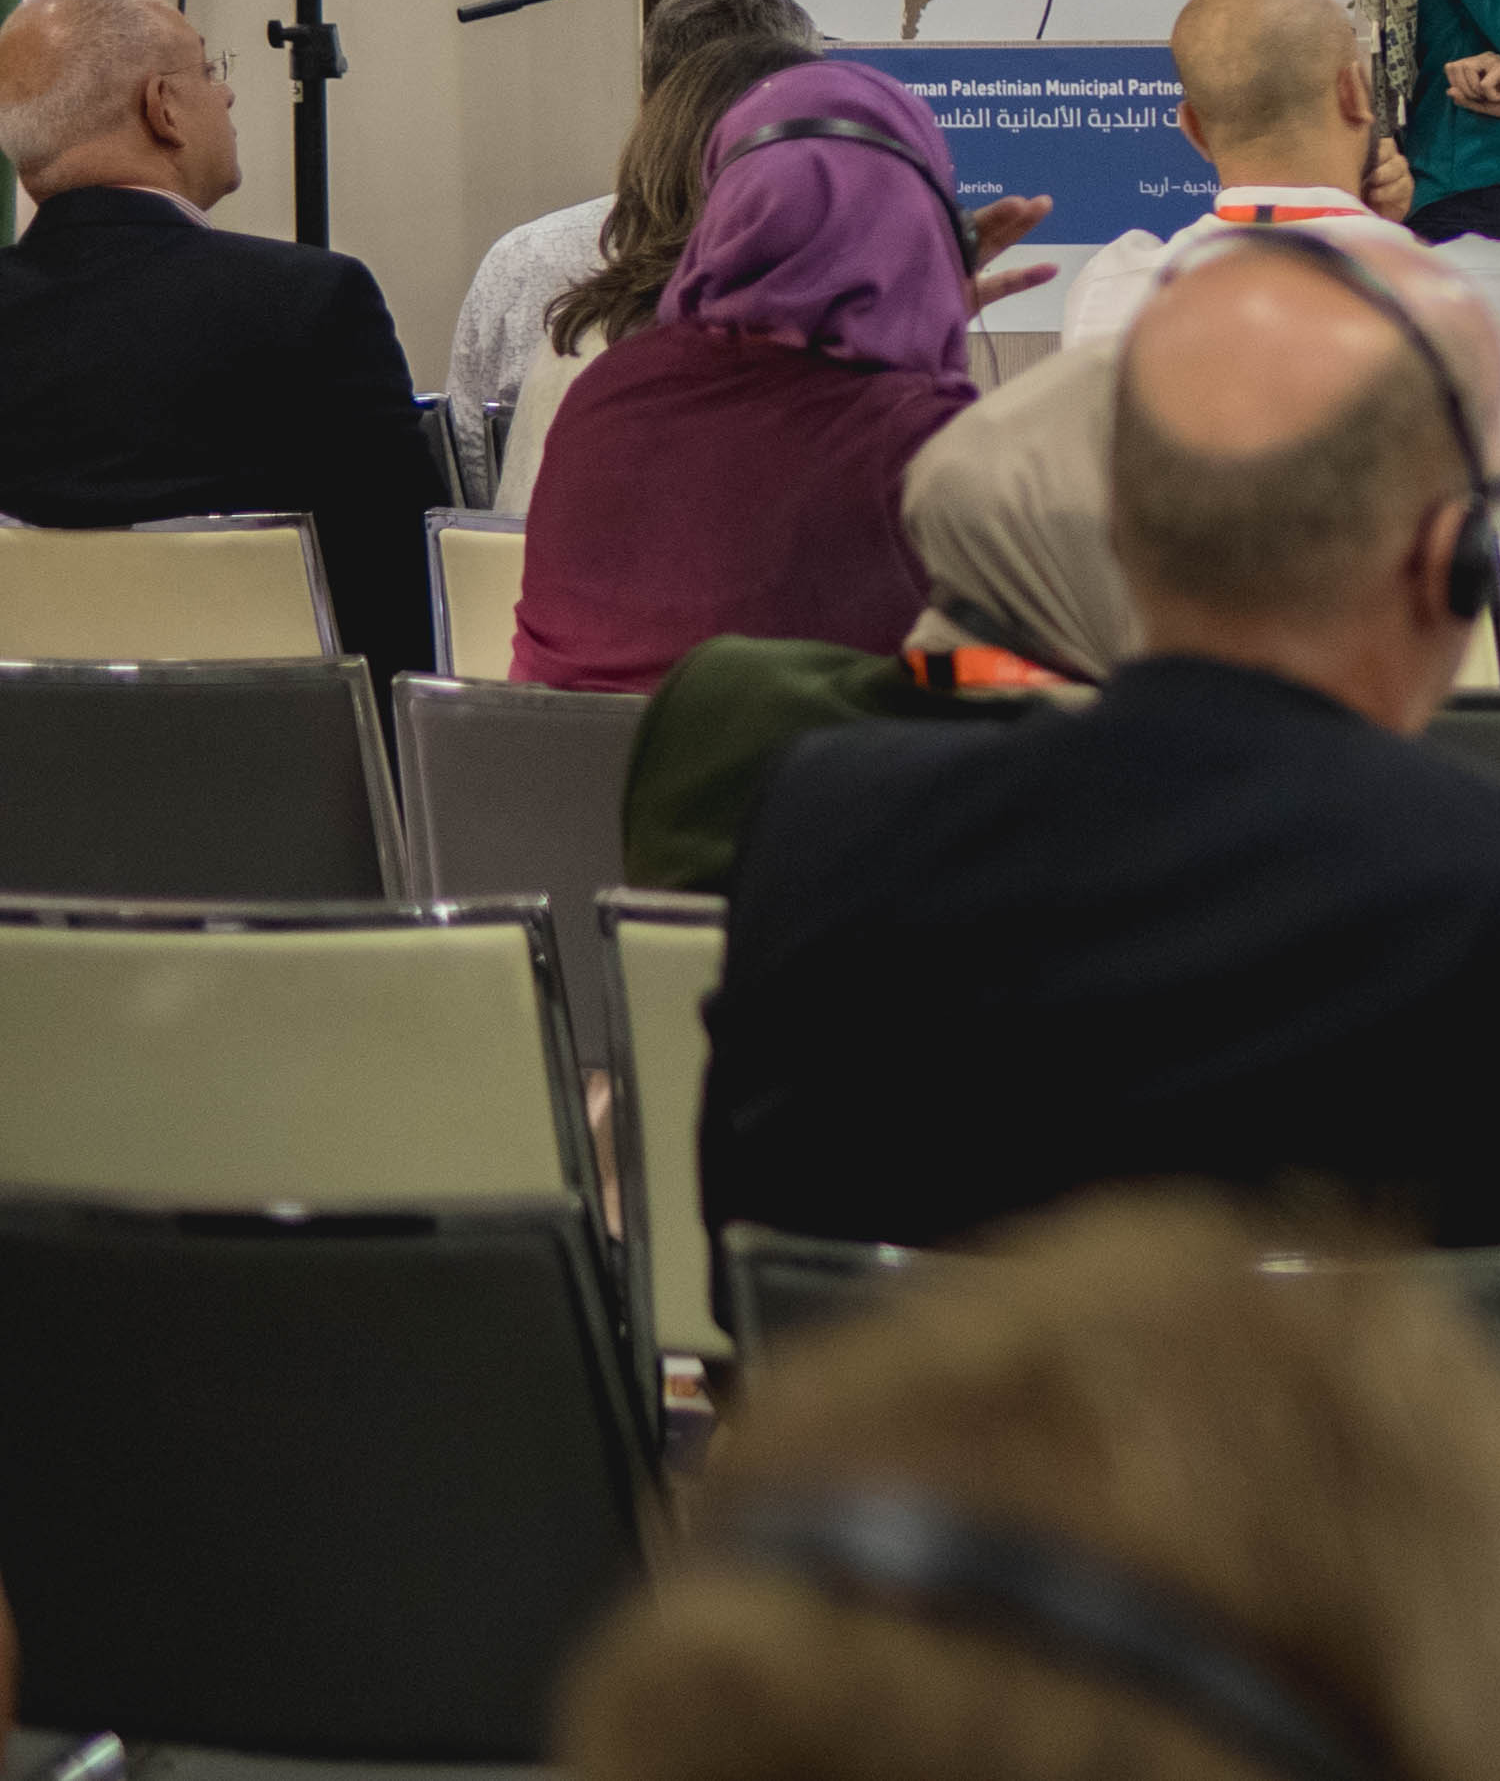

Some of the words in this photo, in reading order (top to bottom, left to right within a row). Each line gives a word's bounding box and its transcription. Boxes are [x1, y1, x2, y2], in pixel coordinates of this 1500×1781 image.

[951, 78, 1042, 96] Palestinian
[1045, 78, 1124, 99] Municipal
[1127, 78, 1184, 96] Partne
[996, 105, 1081, 133] الألمانية
[1087, 107, 1156, 133] البلدية
[956, 180, 1003, 195] Jericho
[1139, 176, 1169, 198] أريحا
